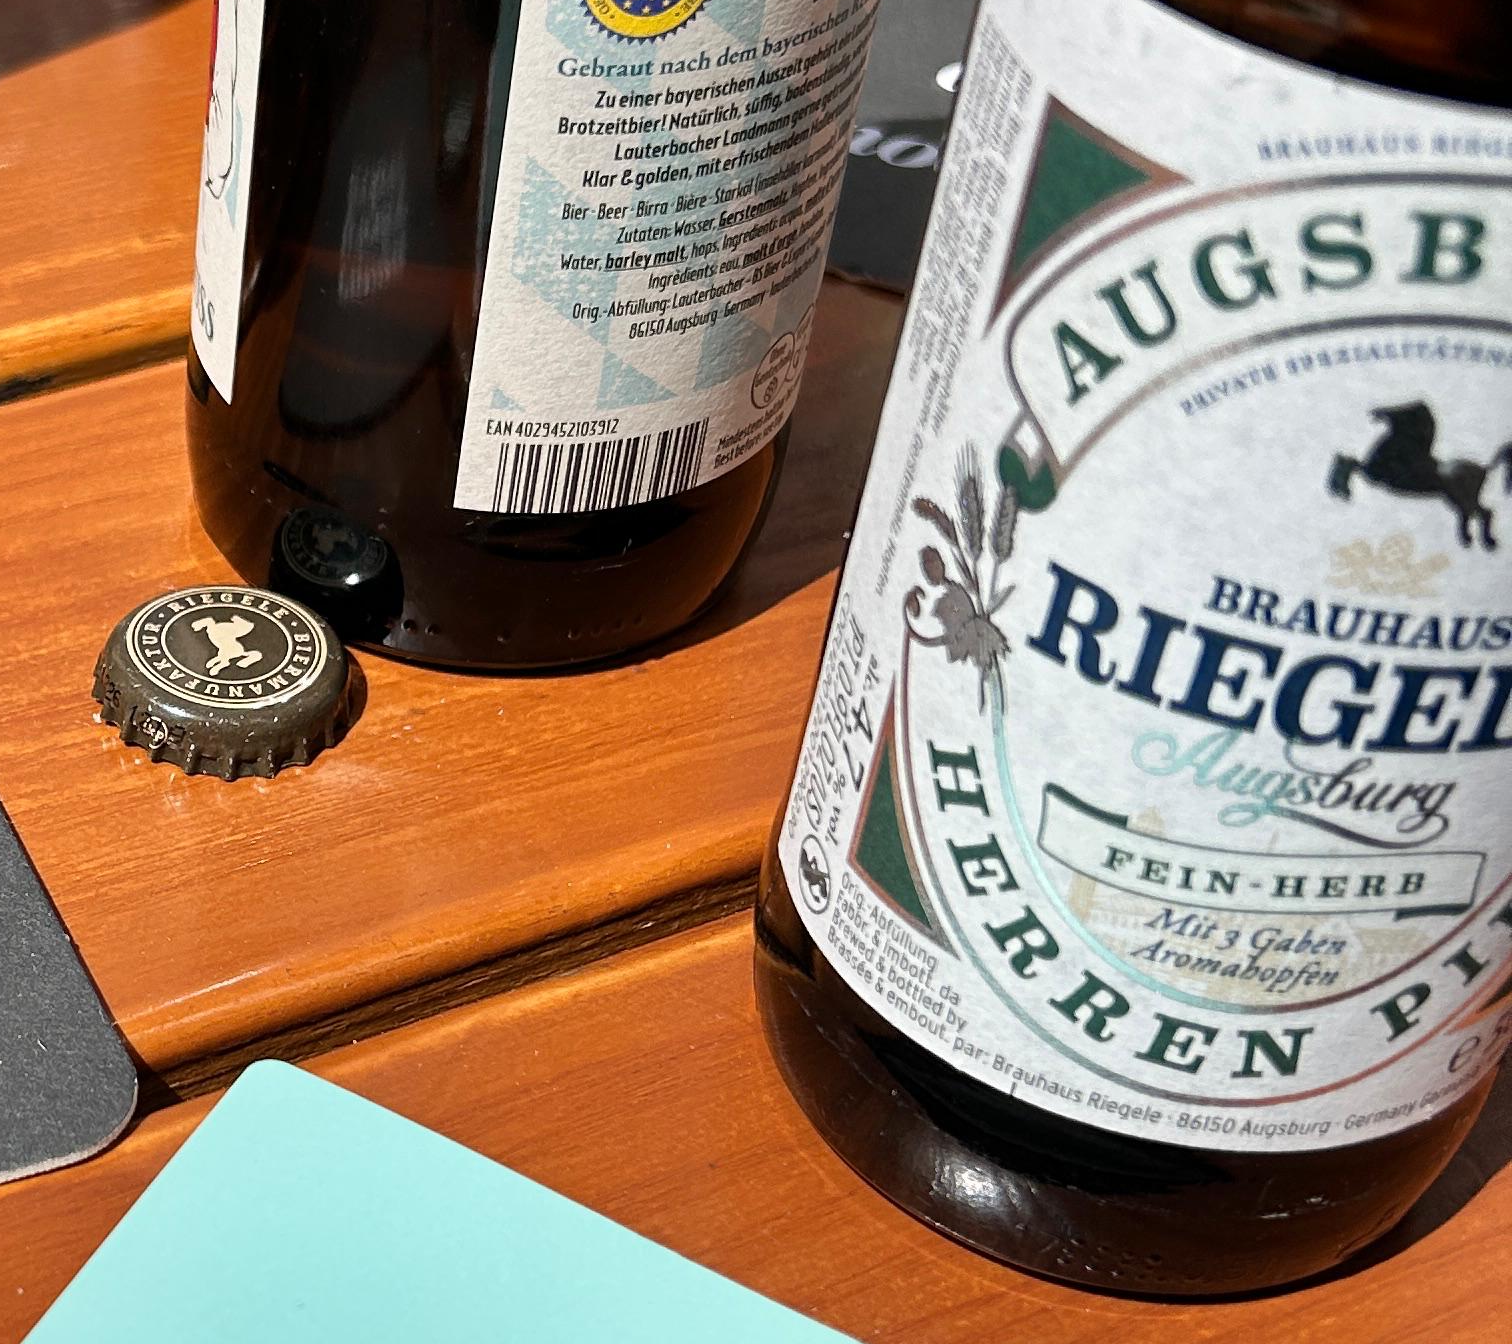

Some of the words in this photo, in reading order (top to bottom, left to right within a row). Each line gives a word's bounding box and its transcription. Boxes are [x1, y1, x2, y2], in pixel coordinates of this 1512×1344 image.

[558, 56, 655, 78] Gebraut
[659, 50, 710, 76] nach
[716, 46, 757, 68] dem
[762, 9, 849, 58] bayerischen
[594, 90, 616, 108] Zu
[619, 89, 663, 107] einer
[664, 75, 755, 107] bayerischen
[756, 57, 803, 88] Auszeit
[557, 113, 666, 136] Brotzeitbier!
[668, 102, 742, 131] Natürlich,
[745, 92, 783, 117] süffig,
[614, 134, 722, 161] Lauterbacher
[723, 112, 790, 146] Landmann
[790, 95, 821, 129] gerne
[582, 170, 617, 188] Klar
[620, 169, 634, 186] &
[635, 165, 692, 191] golden,
[695, 157, 722, 178] mit
[722, 127, 810, 170] erfrischendem
[561, 203, 590, 220] Bier
[597, 202, 629, 220] Beer
[636, 200, 668, 218] Birra
[674, 194, 708, 214] Bière
[615, 226, 672, 244] Zutaten:
[674, 217, 716, 237] Wasser,
[560, 253, 602, 272] Water,
[604, 252, 650, 271] barley
[743, 244, 769, 269] malt
[672, 278, 744, 310] Lauterbacher
[628, 319, 665, 339] 86150
[665, 309, 718, 335] Augsburg
[486, 419, 513, 437] EAN
[515, 418, 620, 438] 4029452103912
[167, 592, 290, 620] RIEGELE
[1205, 575, 1512, 654] BRAUHAUS
[141, 619, 313, 698] BIERMANUFAKTUR
[1131, 728, 1457, 850] Augsburg
[1100, 843, 1427, 902] FEIN-HERB
[841, 871, 939, 973] Orig.-Abfüllung
[926, 738, 1314, 1079] HERREN
[1144, 907, 1214, 941] Mit
[1216, 927, 1242, 951] 3
[1250, 928, 1348, 964] Gaben
[830, 906, 875, 964] Brewed
[875, 955, 886, 973] &
[887, 967, 945, 1017] bottled
[945, 1007, 967, 1033] by
[836, 890, 870, 939] Fabbr.
[871, 930, 880, 947] &
[939, 985, 962, 1007] da
[1128, 937, 1343, 995] Aromahopfen
[827, 926, 873, 986] Brassée
[874, 977, 884, 996] &
[886, 990, 950, 1044] embout.
[953, 1034, 988, 1065] par:
[992, 1054, 1084, 1105] Brauhaus
[1086, 1090, 1164, 1126] Riegele
[1176, 1113, 1236, 1135] 86150
[1238, 1118, 1332, 1140] Augsburg
[1343, 1098, 1418, 1131] Germany
